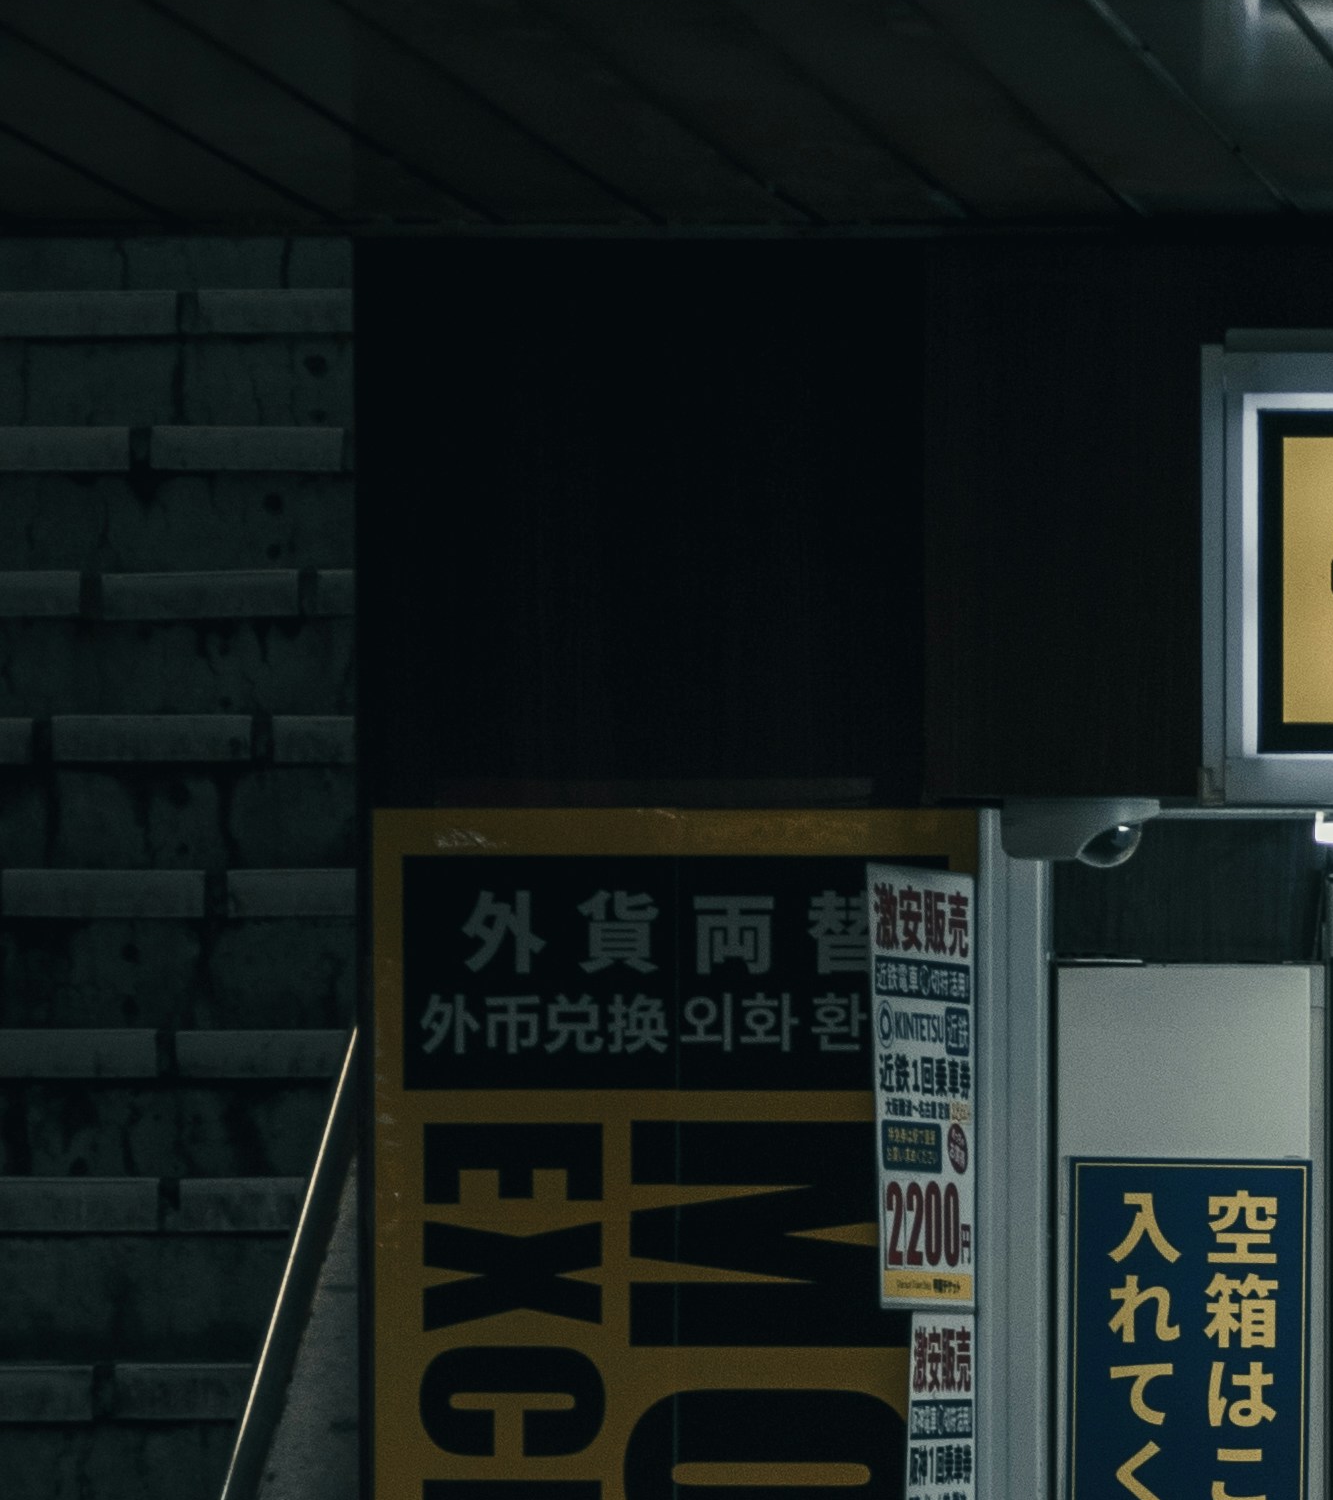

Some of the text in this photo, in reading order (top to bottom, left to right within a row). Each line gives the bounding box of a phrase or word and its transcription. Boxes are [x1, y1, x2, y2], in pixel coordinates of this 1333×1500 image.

[461, 889, 871, 976] 外貨両替
[873, 884, 969, 957] 激安販売
[680, 992, 799, 1054] 외화
[885, 1180, 972, 1268] 2200円
